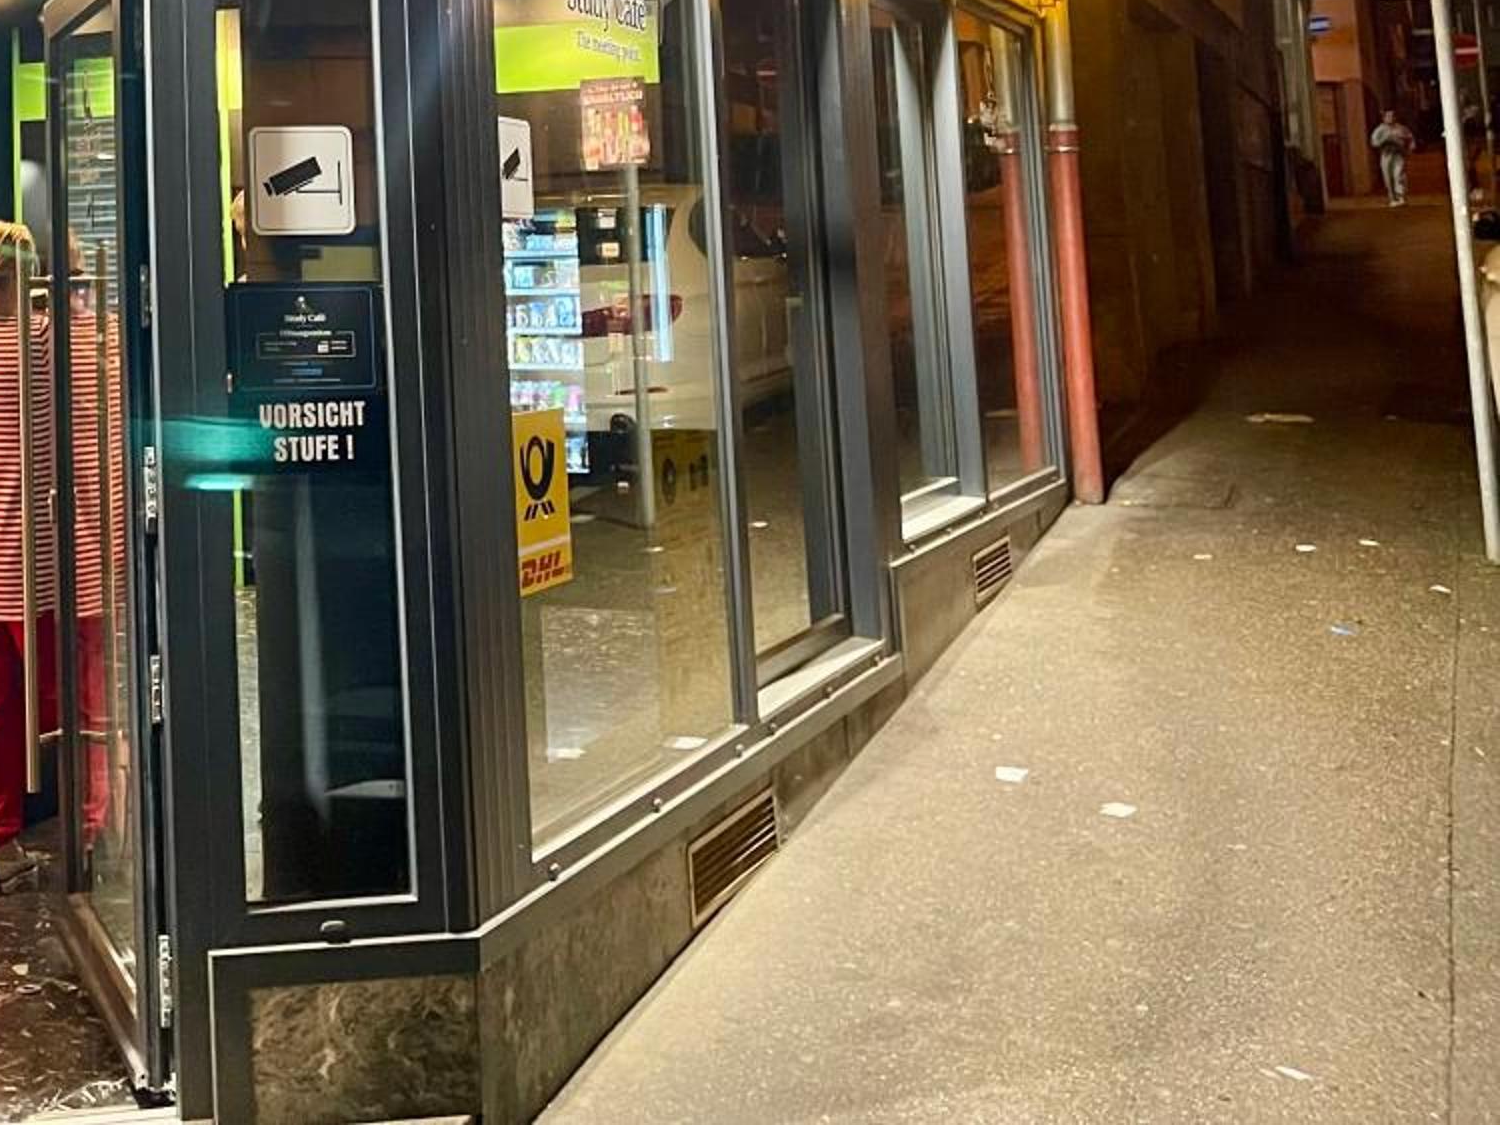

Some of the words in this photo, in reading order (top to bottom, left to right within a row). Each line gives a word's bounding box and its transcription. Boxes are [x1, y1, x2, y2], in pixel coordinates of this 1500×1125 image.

[259, 400, 366, 429] VORSICHT
[273, 434, 340, 462] STUFE
[346, 434, 355, 460] !
[521, 551, 565, 590] DHL
